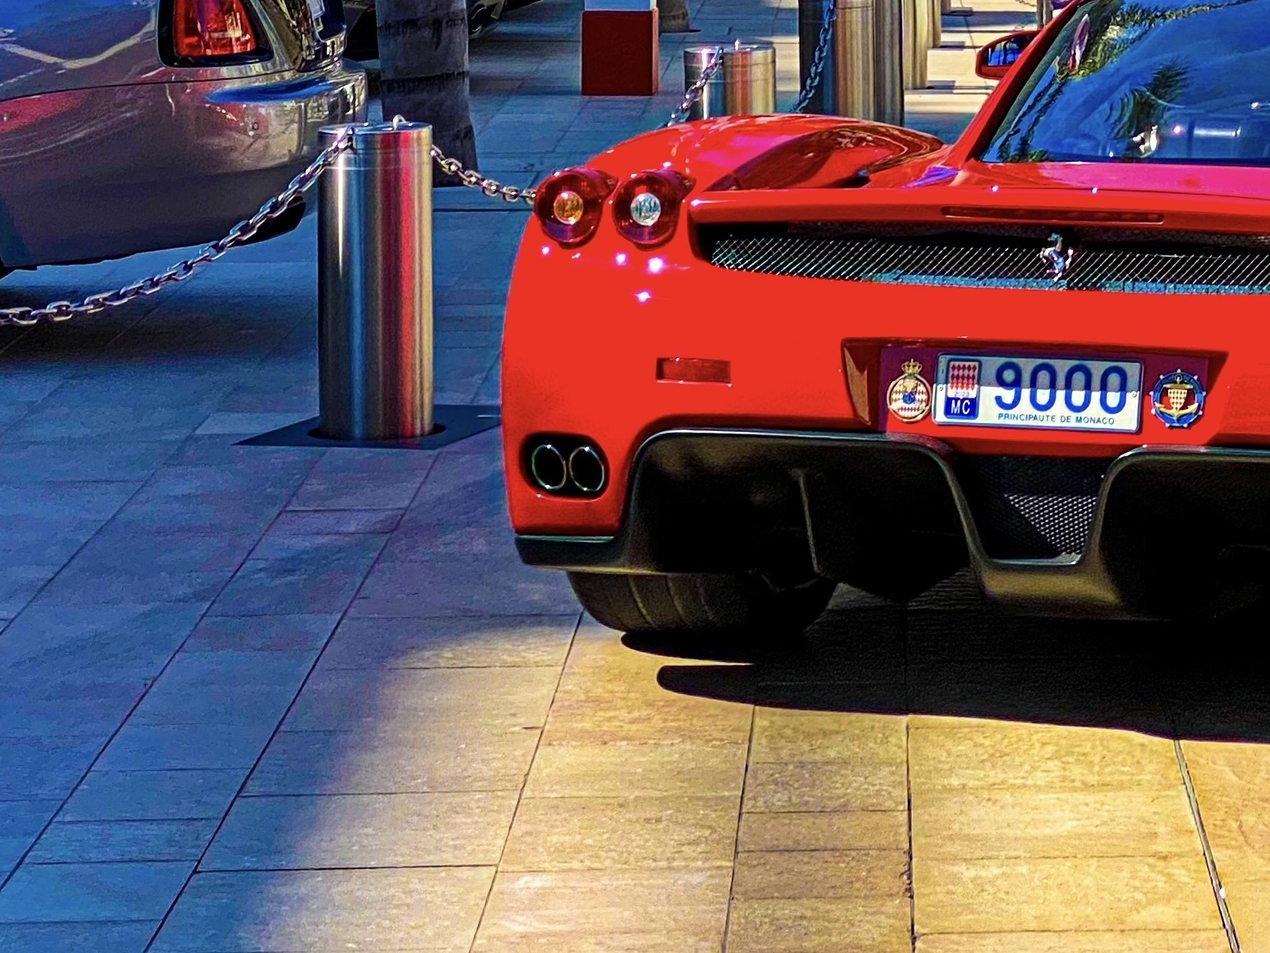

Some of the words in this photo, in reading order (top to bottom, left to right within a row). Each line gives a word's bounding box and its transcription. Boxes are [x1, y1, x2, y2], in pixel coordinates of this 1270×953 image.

[994, 361, 1128, 415] 9000
[950, 399, 971, 415] MC
[998, 412, 1057, 423] PRINCIPAUTE
[1060, 415, 1071, 423] DE
[1075, 416, 1115, 426] MONACO
